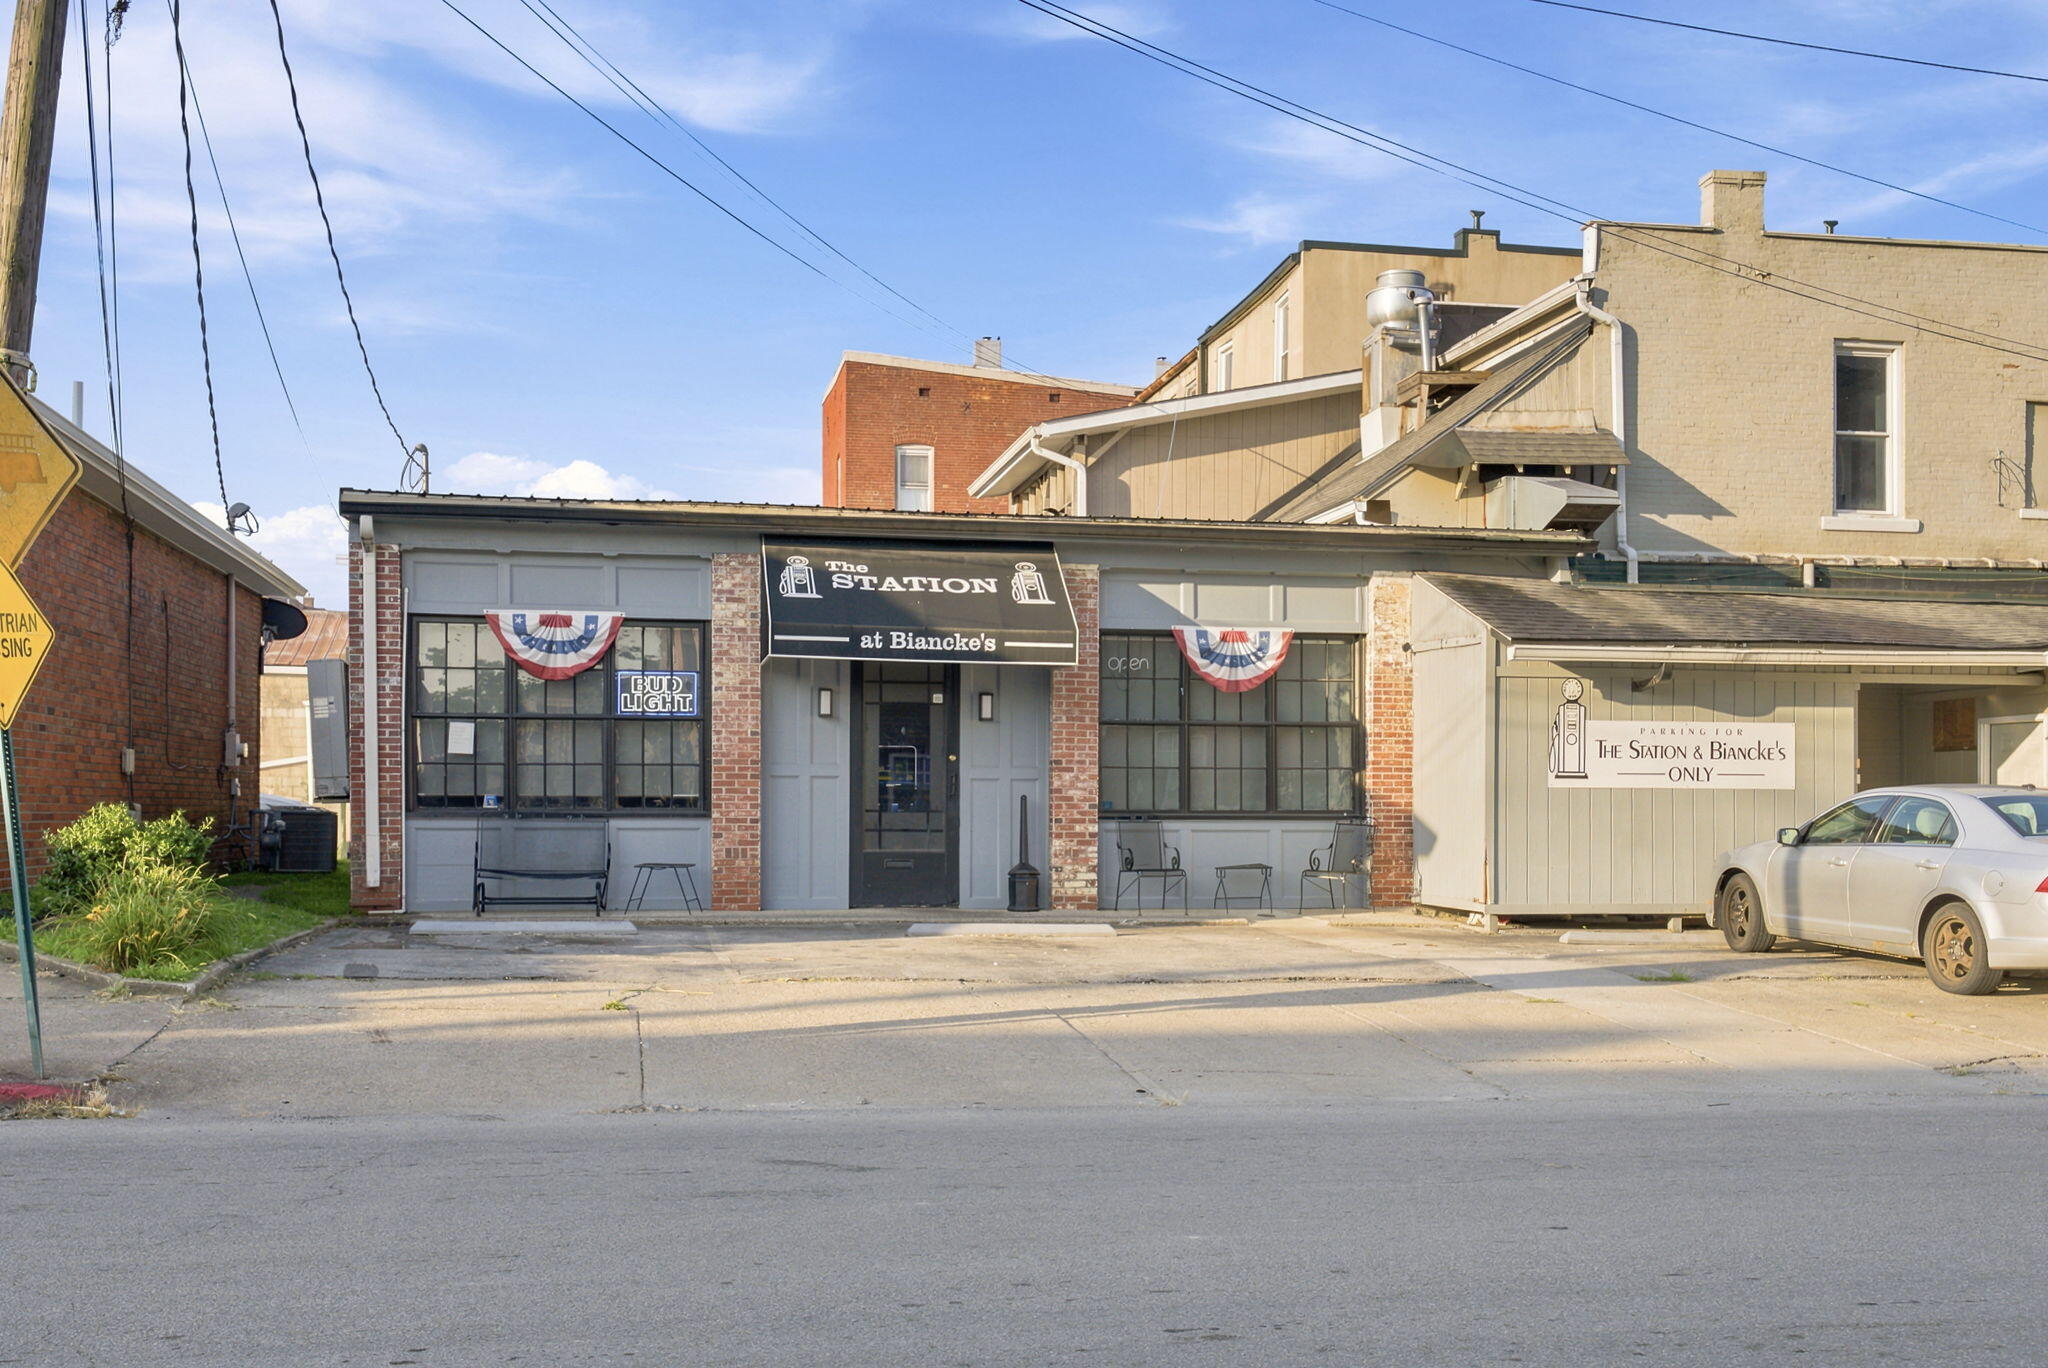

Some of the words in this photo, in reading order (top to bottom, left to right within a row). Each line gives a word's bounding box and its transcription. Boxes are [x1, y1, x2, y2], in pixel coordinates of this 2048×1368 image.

[824, 560, 869, 574] The
[831, 573, 998, 594] STATION
[0, 637, 33, 658] SING
[860, 630, 883, 649] at
[889, 631, 996, 652] Biancke's
[1106, 655, 1149, 672] open
[631, 675, 683, 694] BUD
[1640, 728, 1707, 736] PARKING
[1715, 728, 1744, 736] FOR
[1693, 746, 1704, 760] &
[1669, 767, 1714, 782] ONLY
